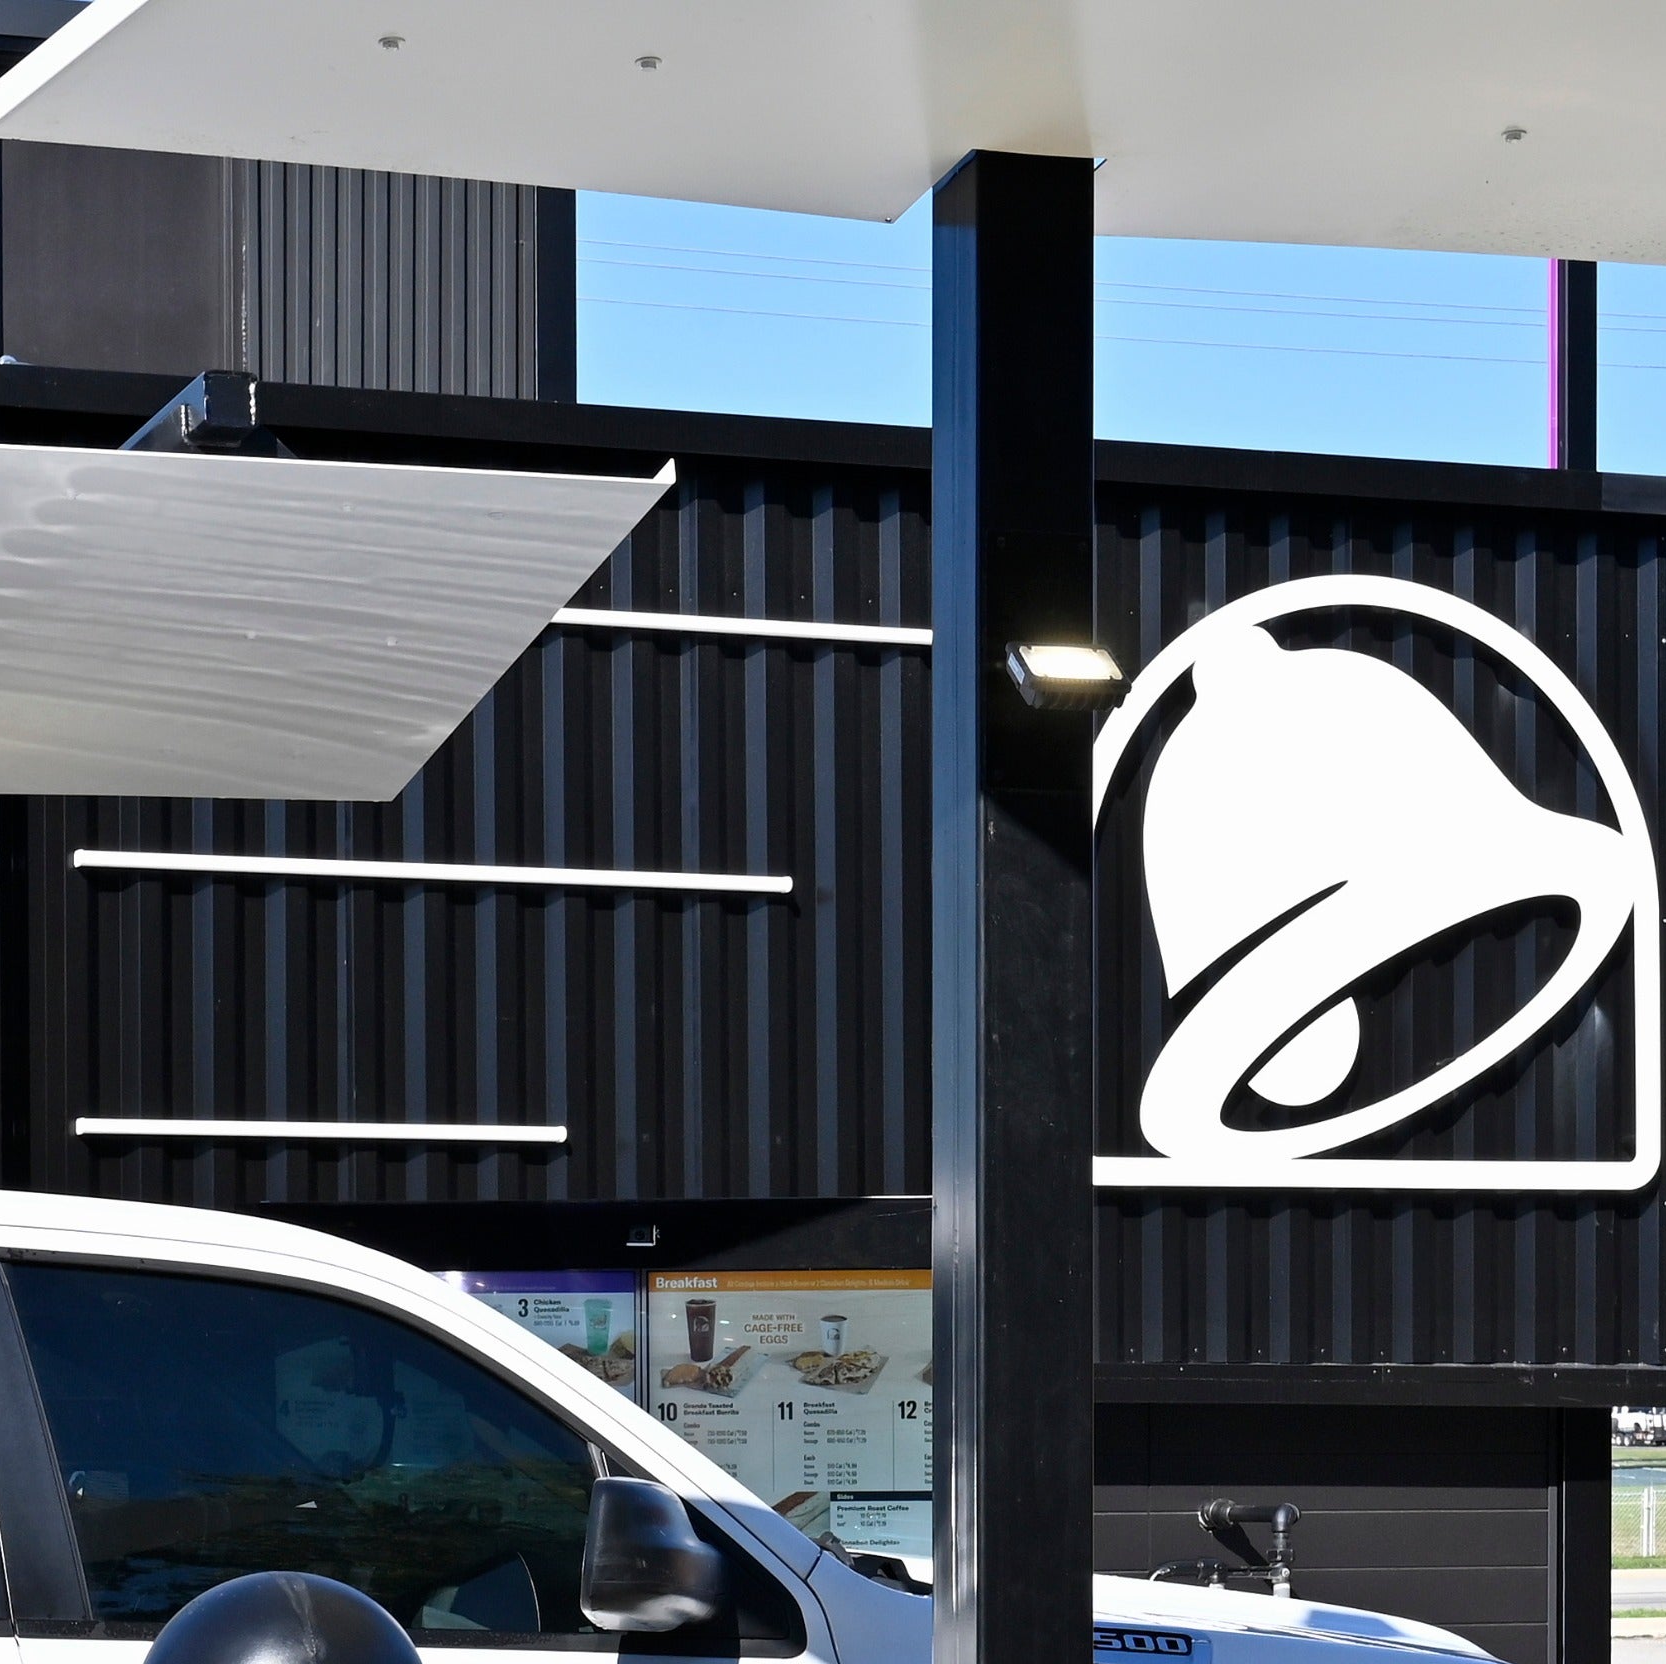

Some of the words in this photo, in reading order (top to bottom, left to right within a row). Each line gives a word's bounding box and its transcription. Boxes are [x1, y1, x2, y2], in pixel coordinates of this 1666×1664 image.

[656, 1278, 718, 1289] Breakfast
[518, 1299, 529, 1317] 3
[744, 1324, 803, 1333] CAGE-FREE
[759, 1335, 788, 1344] EGGS
[658, 1402, 678, 1421] 10
[778, 1401, 793, 1420] 11
[898, 1401, 917, 1419] 12
